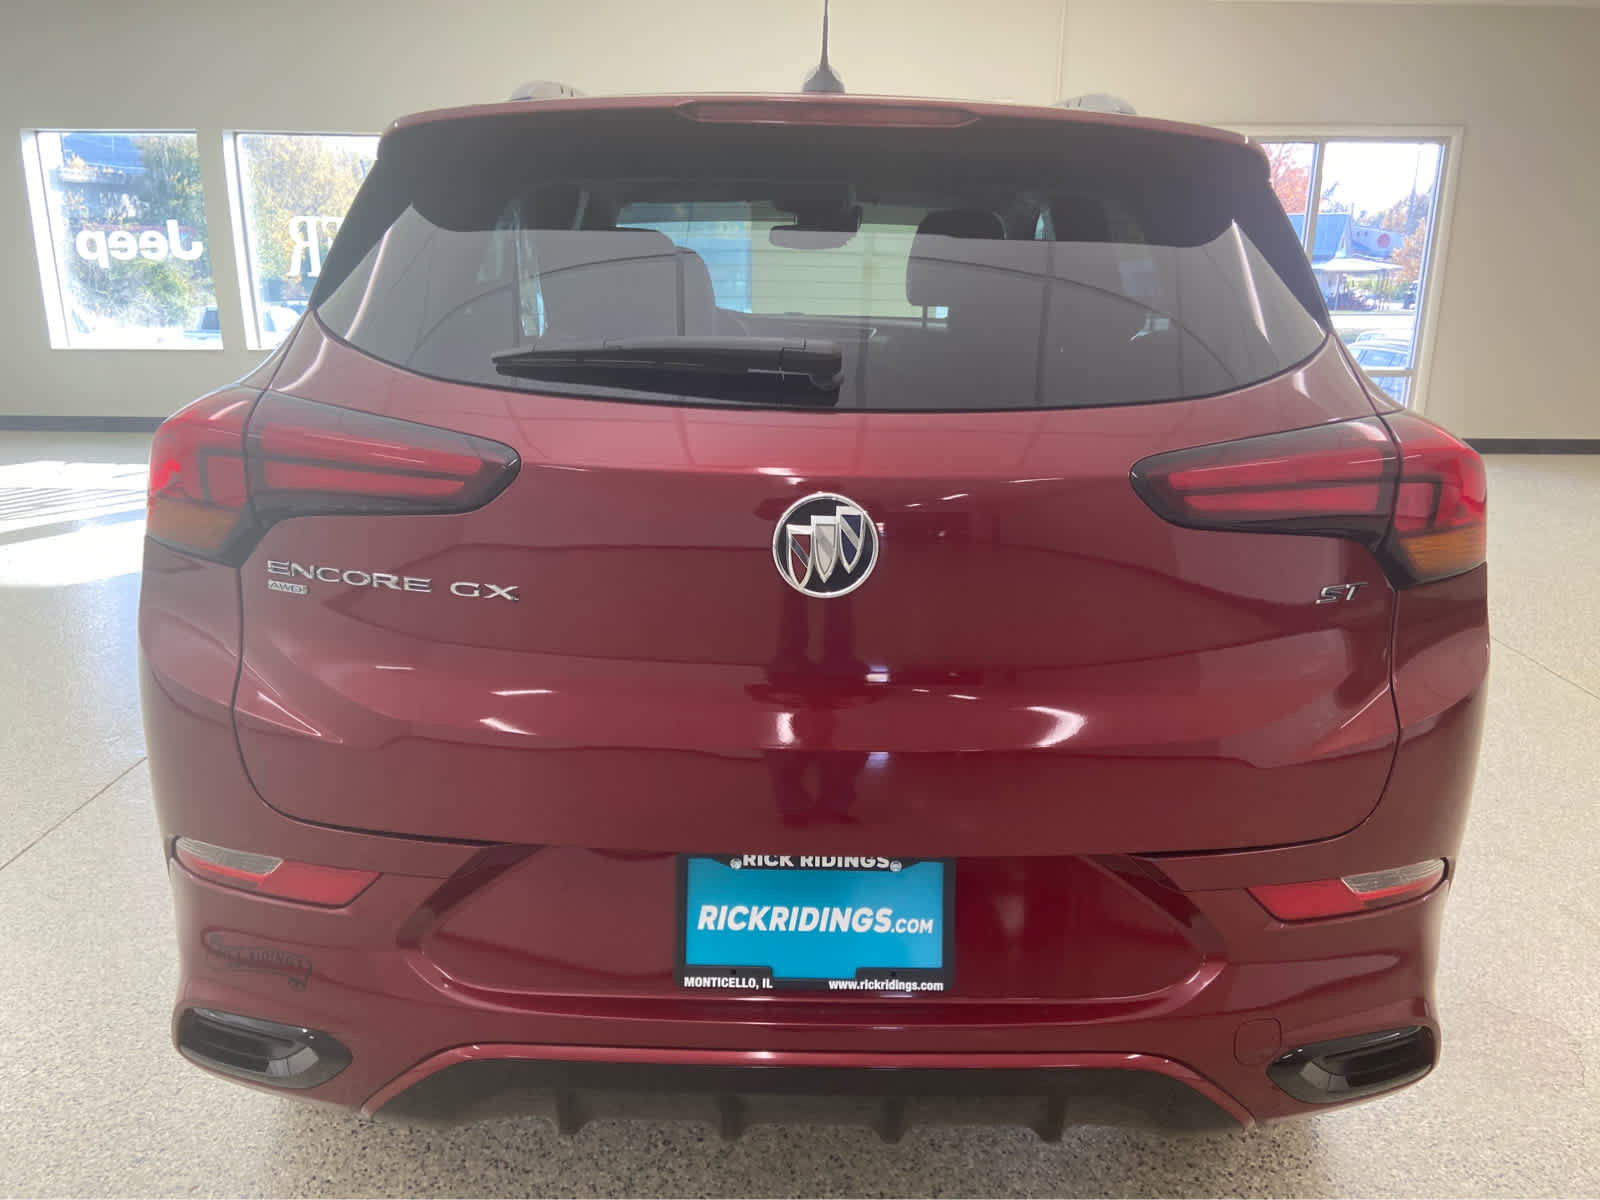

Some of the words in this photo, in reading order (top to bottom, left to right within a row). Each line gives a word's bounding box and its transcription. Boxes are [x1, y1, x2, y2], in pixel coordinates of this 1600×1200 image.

[267, 560, 432, 592] ENCORE
[450, 581, 519, 600] GX
[268, 580, 306, 594] AWD
[1316, 581, 1368, 604] ST
[743, 855, 794, 867] RICK
[697, 905, 934, 934] RICKRIDINGS.COM
[683, 976, 759, 990] MONTICELLO,
[762, 978, 773, 989] IL
[828, 979, 944, 992] www.rickridings.com
